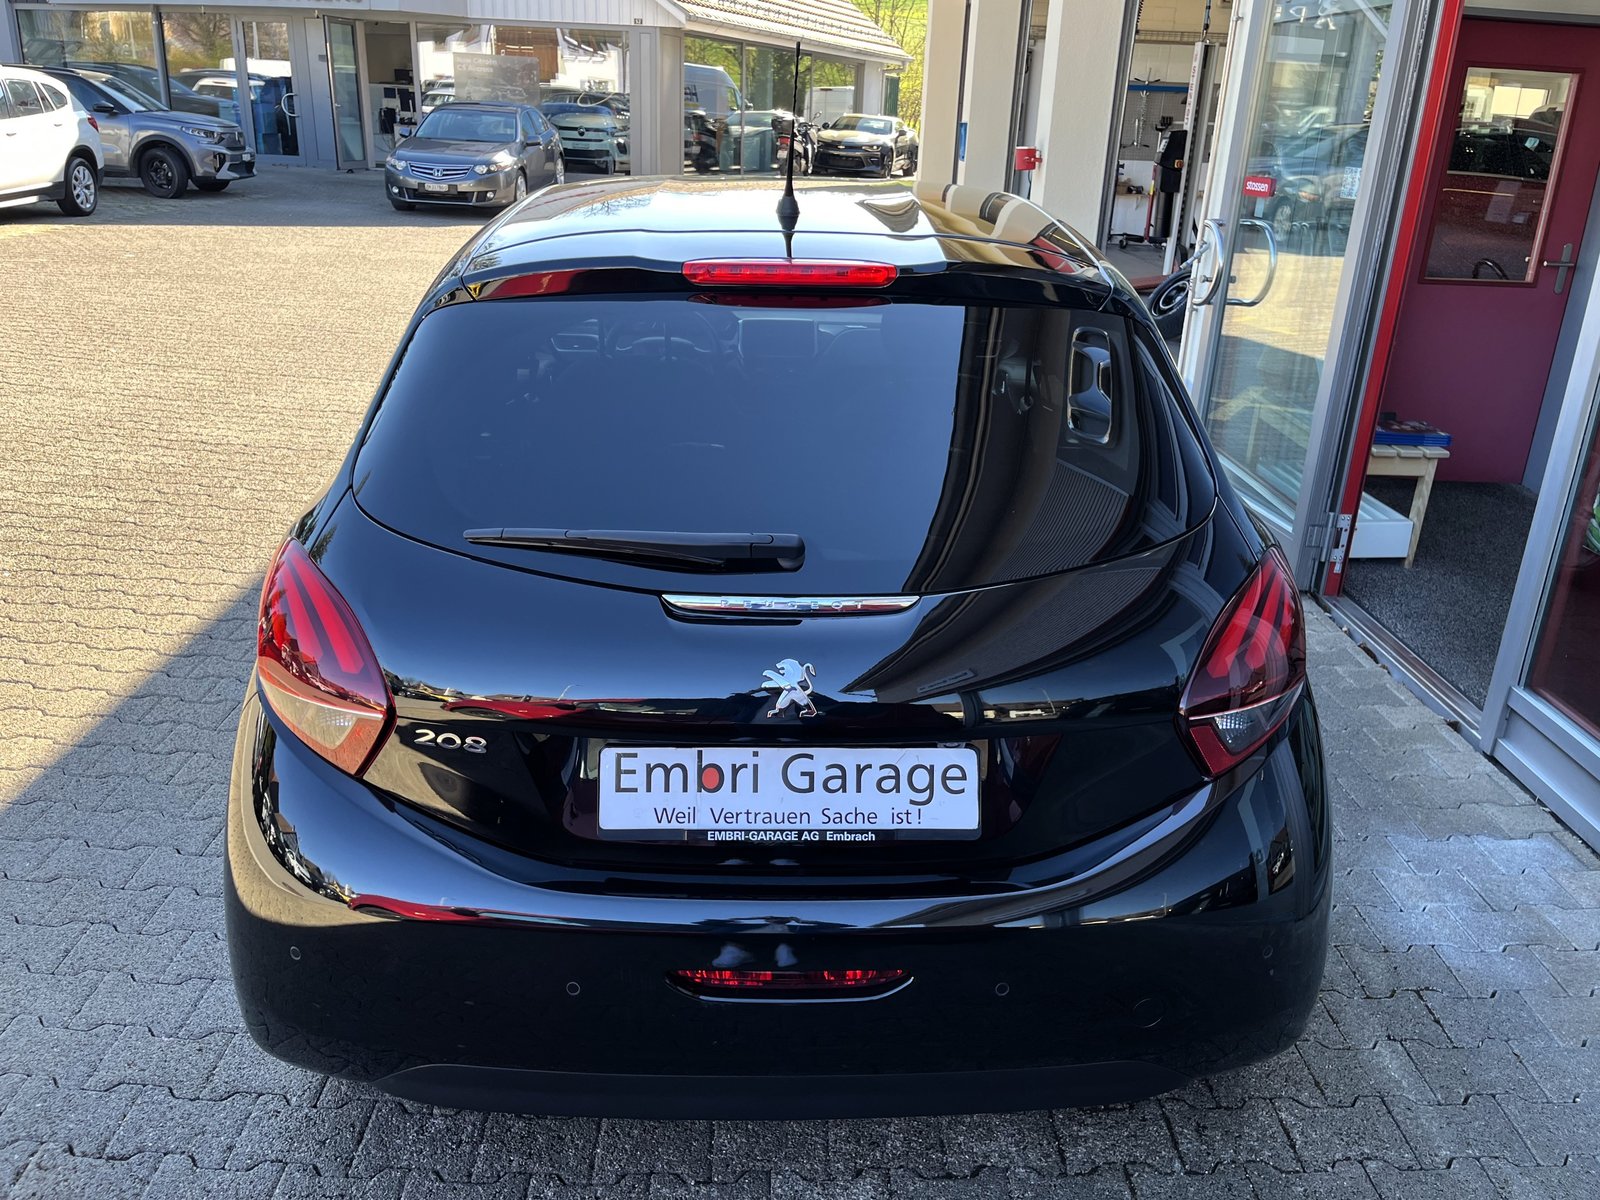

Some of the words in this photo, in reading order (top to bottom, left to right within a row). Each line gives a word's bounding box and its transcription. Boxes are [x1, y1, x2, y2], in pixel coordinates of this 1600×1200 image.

[1246, 181, 1269, 192] stossen
[720, 599, 864, 611] PEUGEOT
[414, 728, 488, 754] 208
[614, 750, 759, 794] Embri
[780, 753, 968, 806] Garage
[653, 807, 697, 825] Weil
[709, 807, 811, 825] Vertrauen
[821, 807, 878, 825] Sache
[707, 831, 799, 841] EMBRI-GARAGE
[801, 831, 820, 841] AG
[826, 831, 876, 841] Embrach
